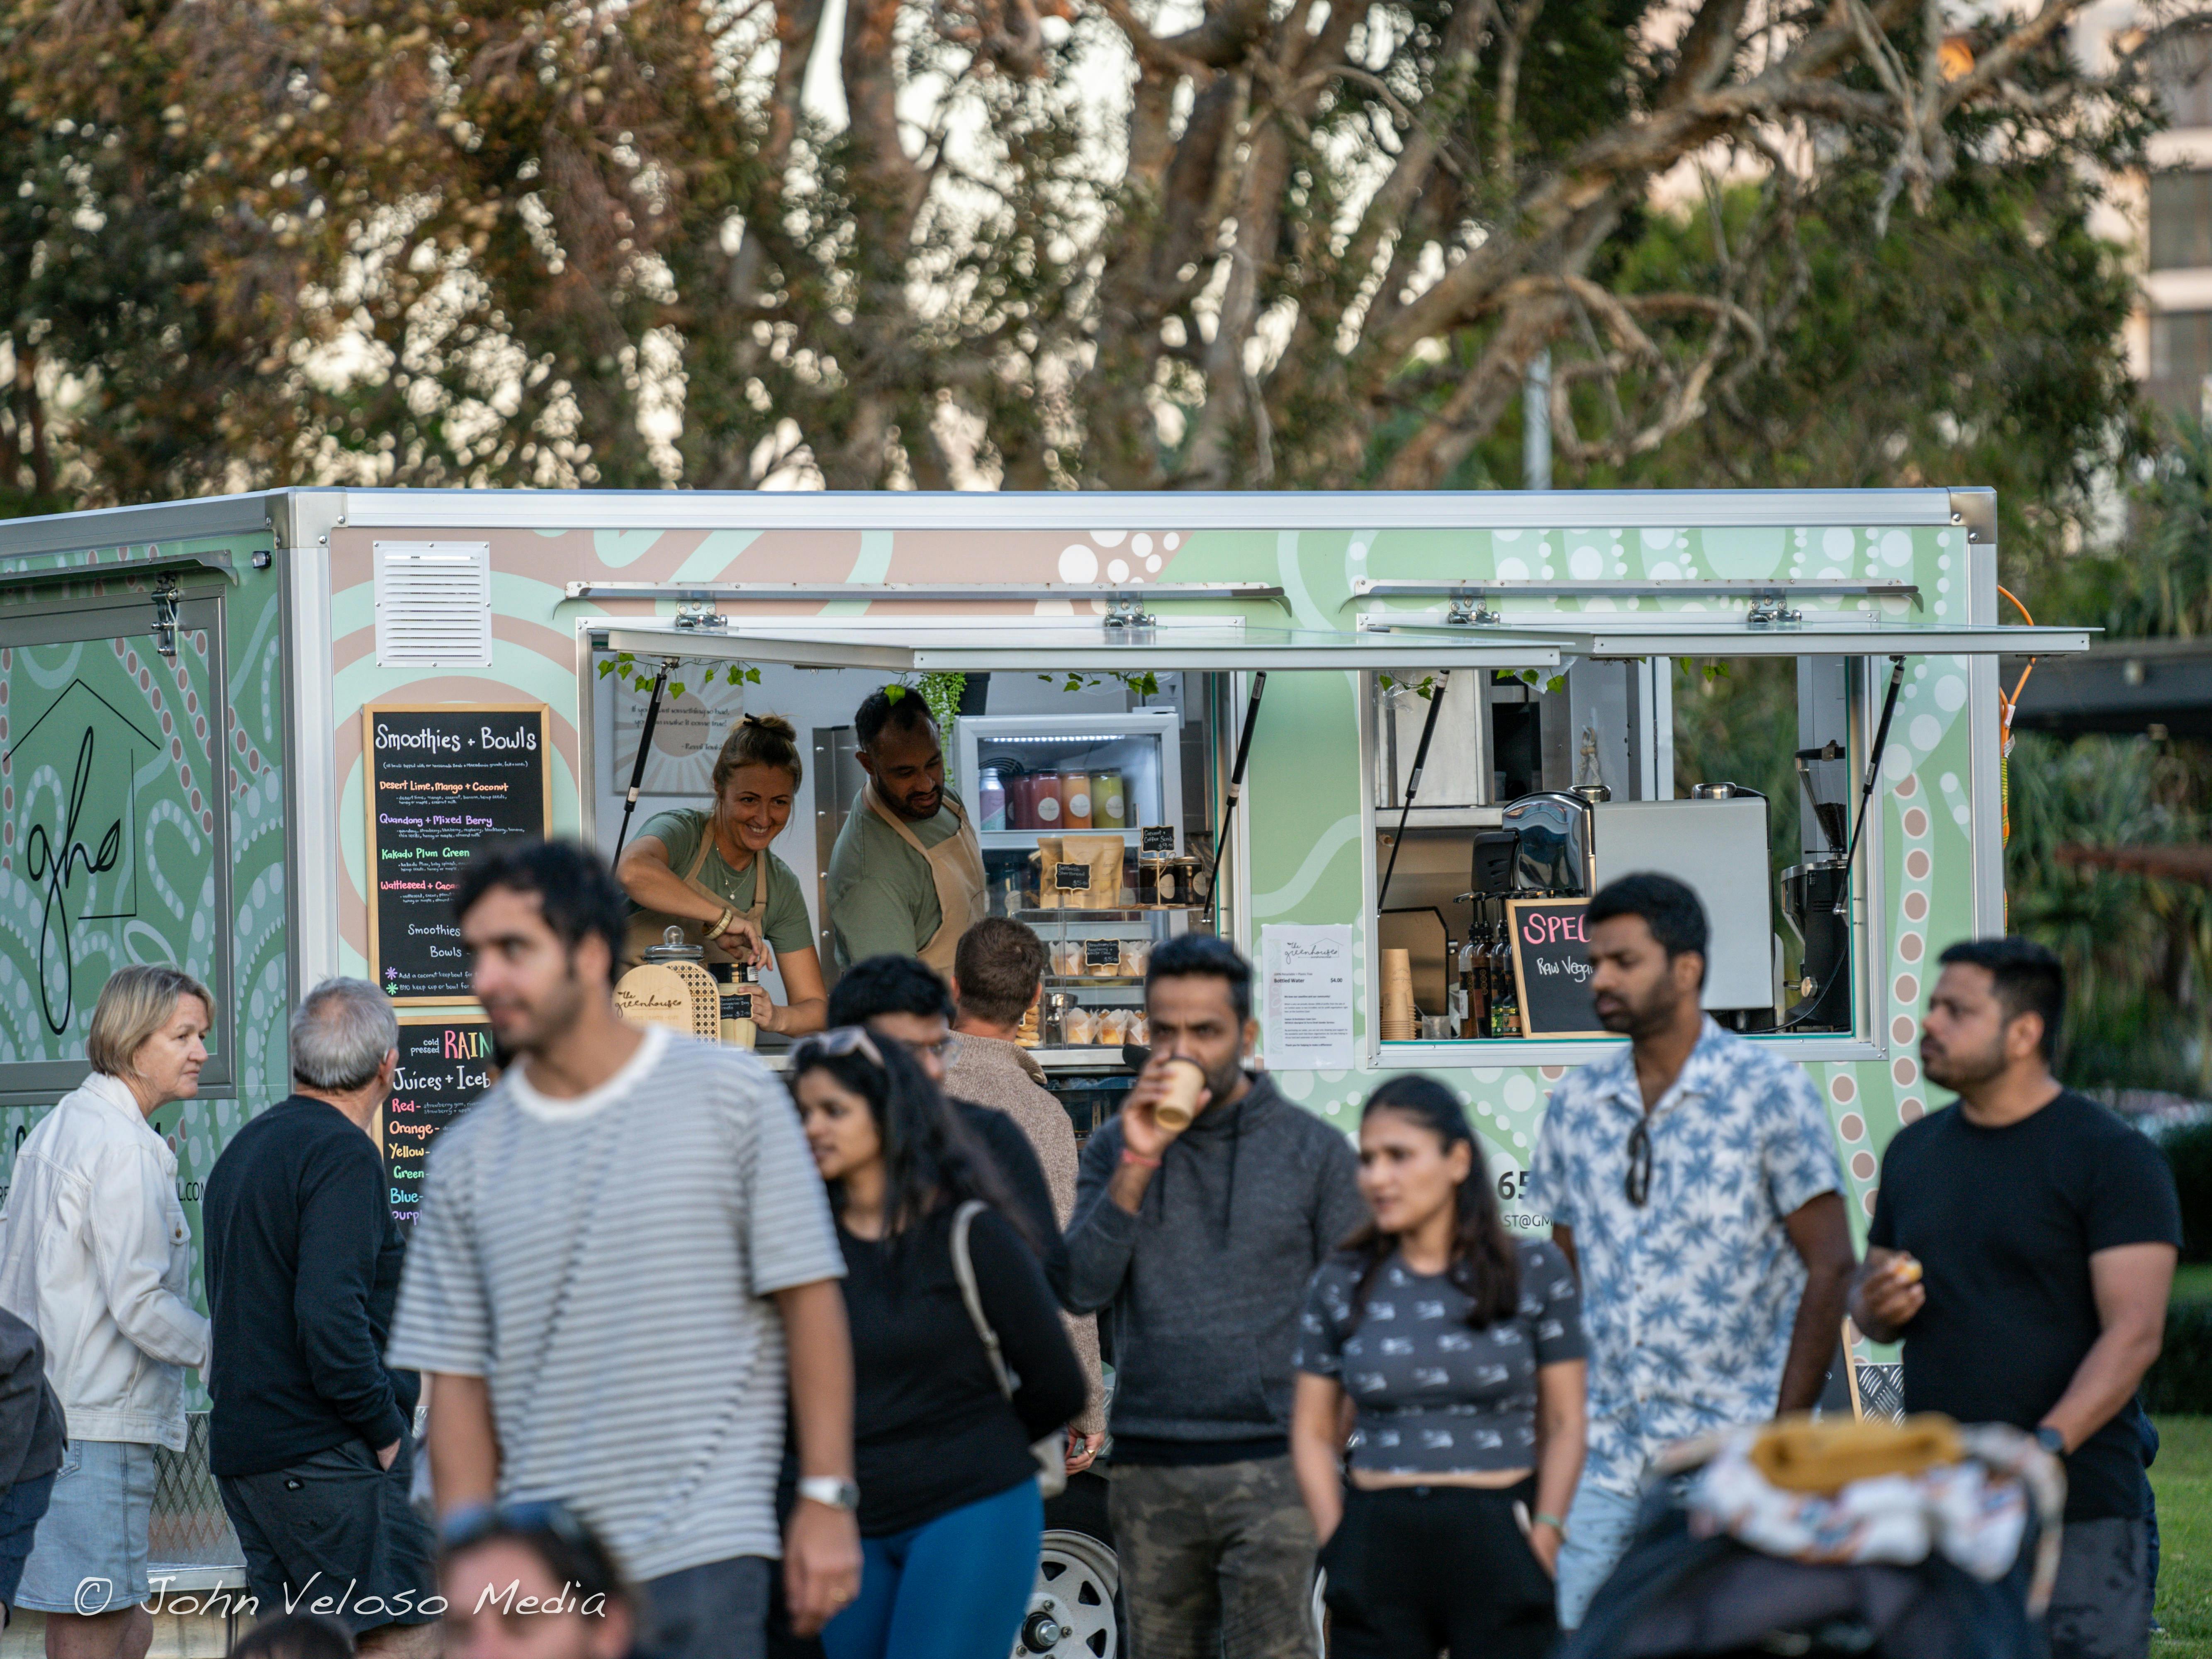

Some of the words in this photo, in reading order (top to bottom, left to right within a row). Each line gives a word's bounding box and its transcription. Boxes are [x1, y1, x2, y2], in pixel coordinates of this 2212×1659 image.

[375, 724, 461, 754] Smoothies
[481, 726, 537, 750] Bowls
[380, 780, 409, 790] Desert
[410, 781, 434, 791] Lime,
[435, 783, 463, 794] Mango
[472, 782, 509, 791] Coconut
[380, 813, 423, 827] Quandong
[433, 815, 462, 825] Mixed
[466, 815, 493, 827] Berry
[382, 849, 413, 860] Kakadu
[416, 848, 438, 859] Plum
[443, 847, 470, 857] Green
[380, 880, 426, 890] Wattleseed
[435, 881, 460, 890] Cacao
[408, 924, 461, 937] Smoothies
[1523, 913, 1591, 944] SPEC
[430, 946, 462, 958] Bowls
[1285, 945, 1337, 964] greenhouse
[1537, 958, 1559, 975] Raw
[615, 995, 681, 1018] greenhouse
[411, 1046, 440, 1056] pressed
[445, 1030, 494, 1060] RAIN
[392, 1067, 442, 1091] Juices
